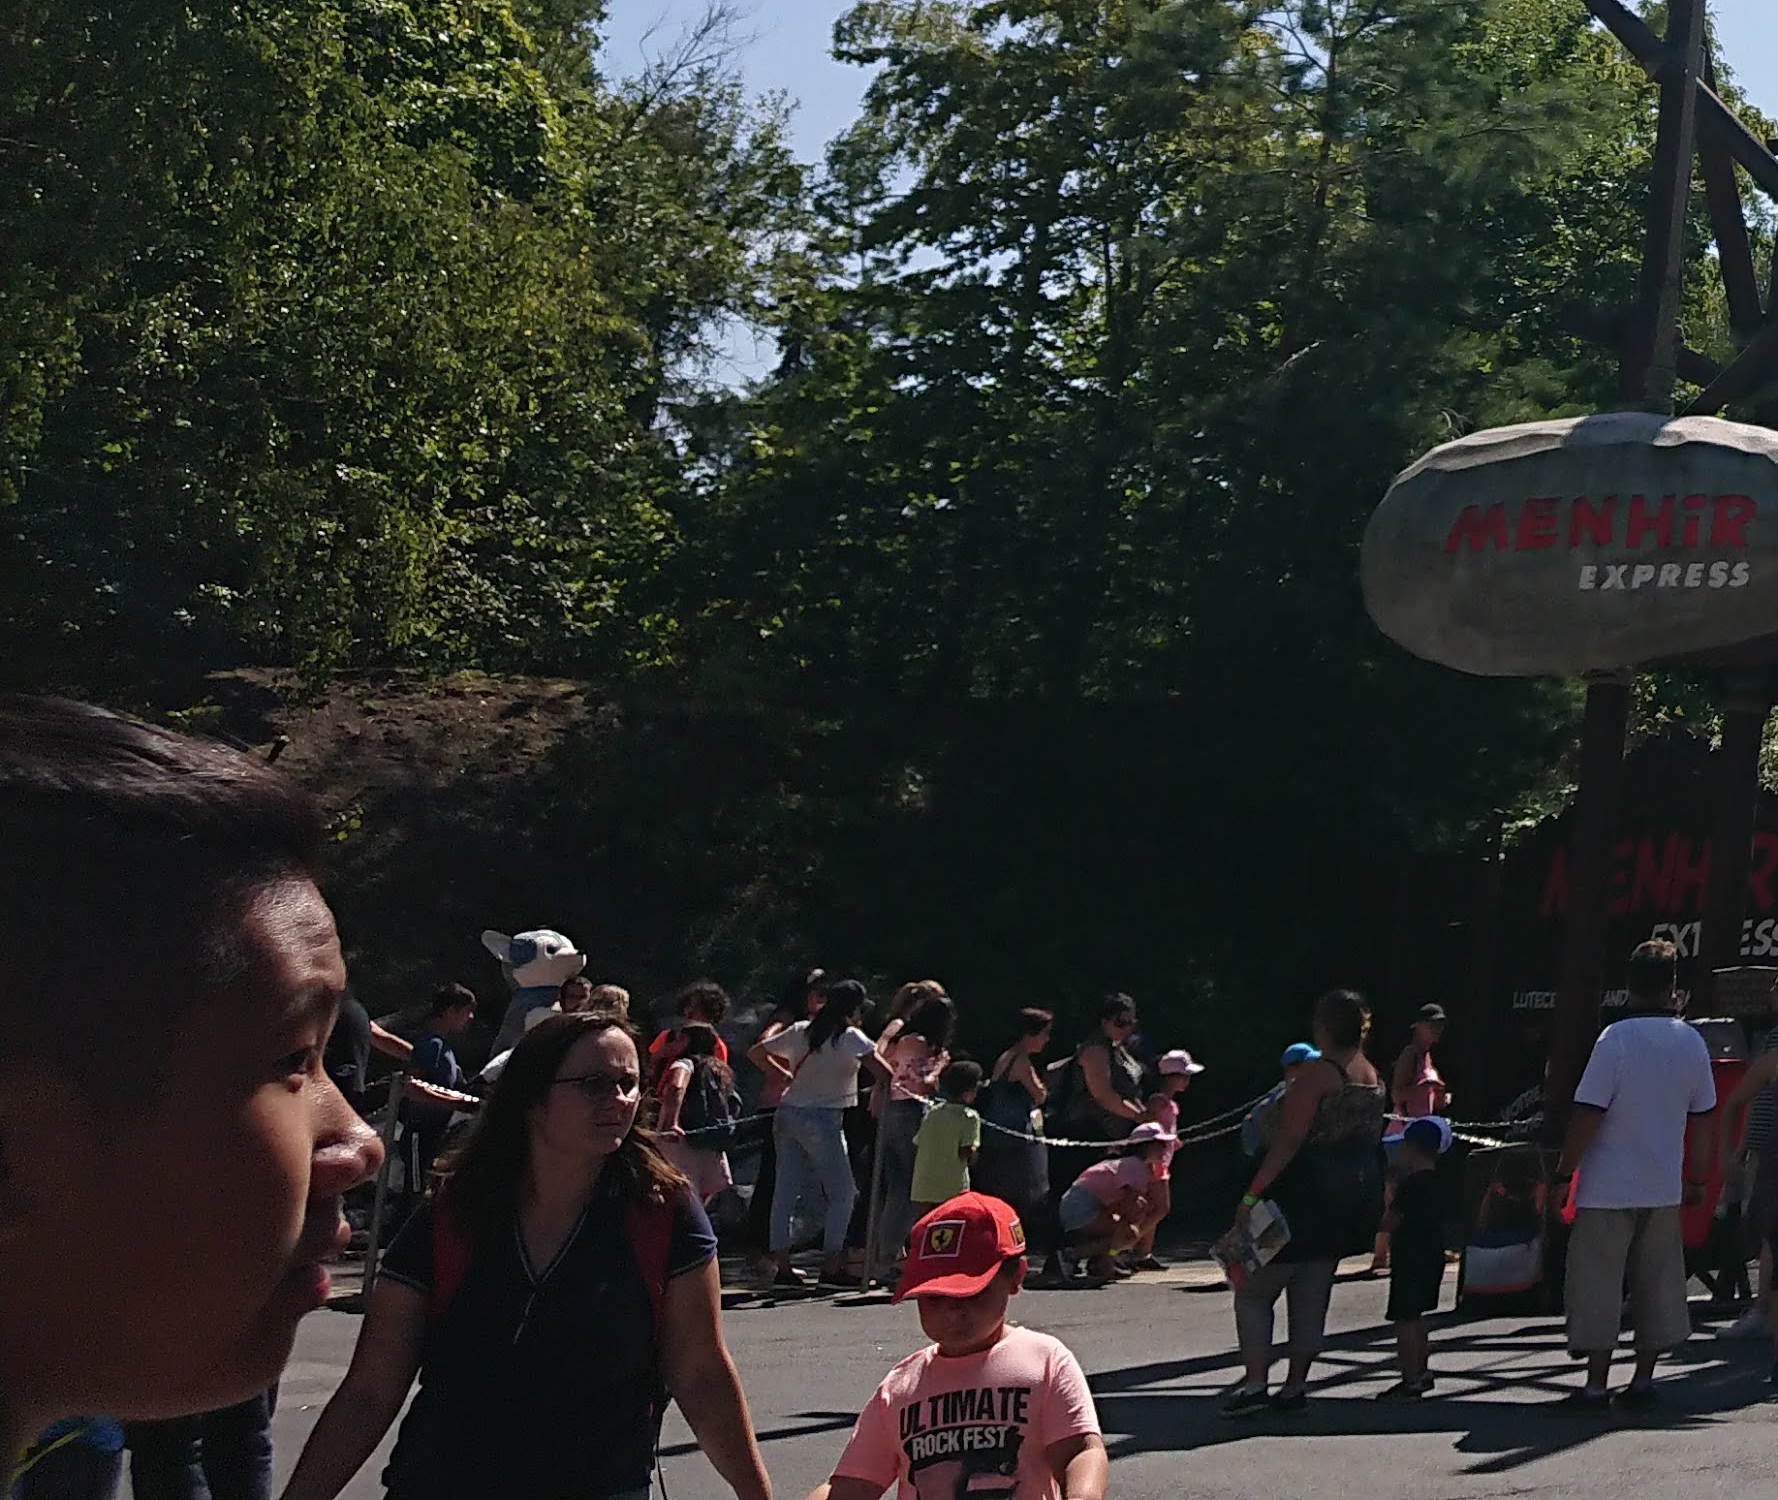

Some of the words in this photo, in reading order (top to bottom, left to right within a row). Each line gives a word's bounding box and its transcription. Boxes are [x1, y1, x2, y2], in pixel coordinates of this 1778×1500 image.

[1578, 560, 1750, 591] EXPRESS
[900, 1387, 1031, 1441] ULTIMATE
[912, 1429, 961, 1461] ROCK
[962, 1425, 1009, 1451] FEST
